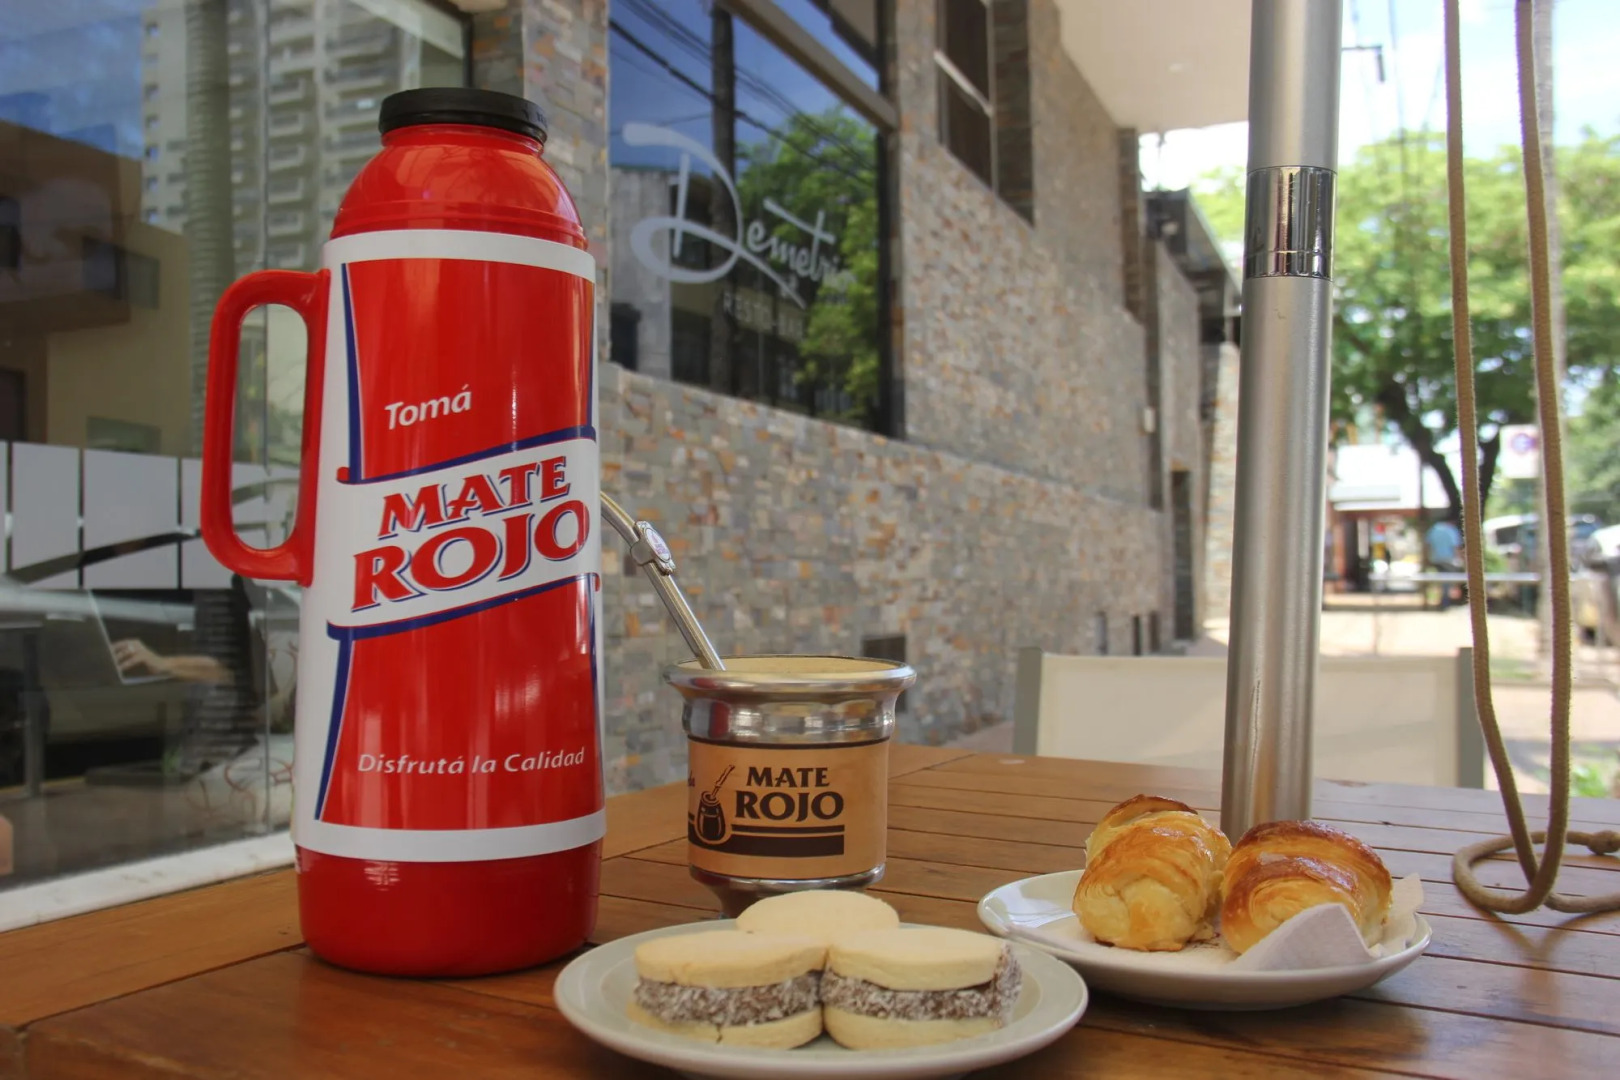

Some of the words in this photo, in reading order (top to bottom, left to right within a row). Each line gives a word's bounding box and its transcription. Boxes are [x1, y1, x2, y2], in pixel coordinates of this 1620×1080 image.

[384, 383, 472, 430] Tomá
[377, 455, 571, 541] MATE
[351, 499, 591, 613] ROJO
[357, 753, 465, 774] Disfrutá
[471, 755, 497, 774] la
[503, 747, 586, 773] Calidad
[746, 766, 830, 788] MATE
[734, 790, 845, 822] ROJO
